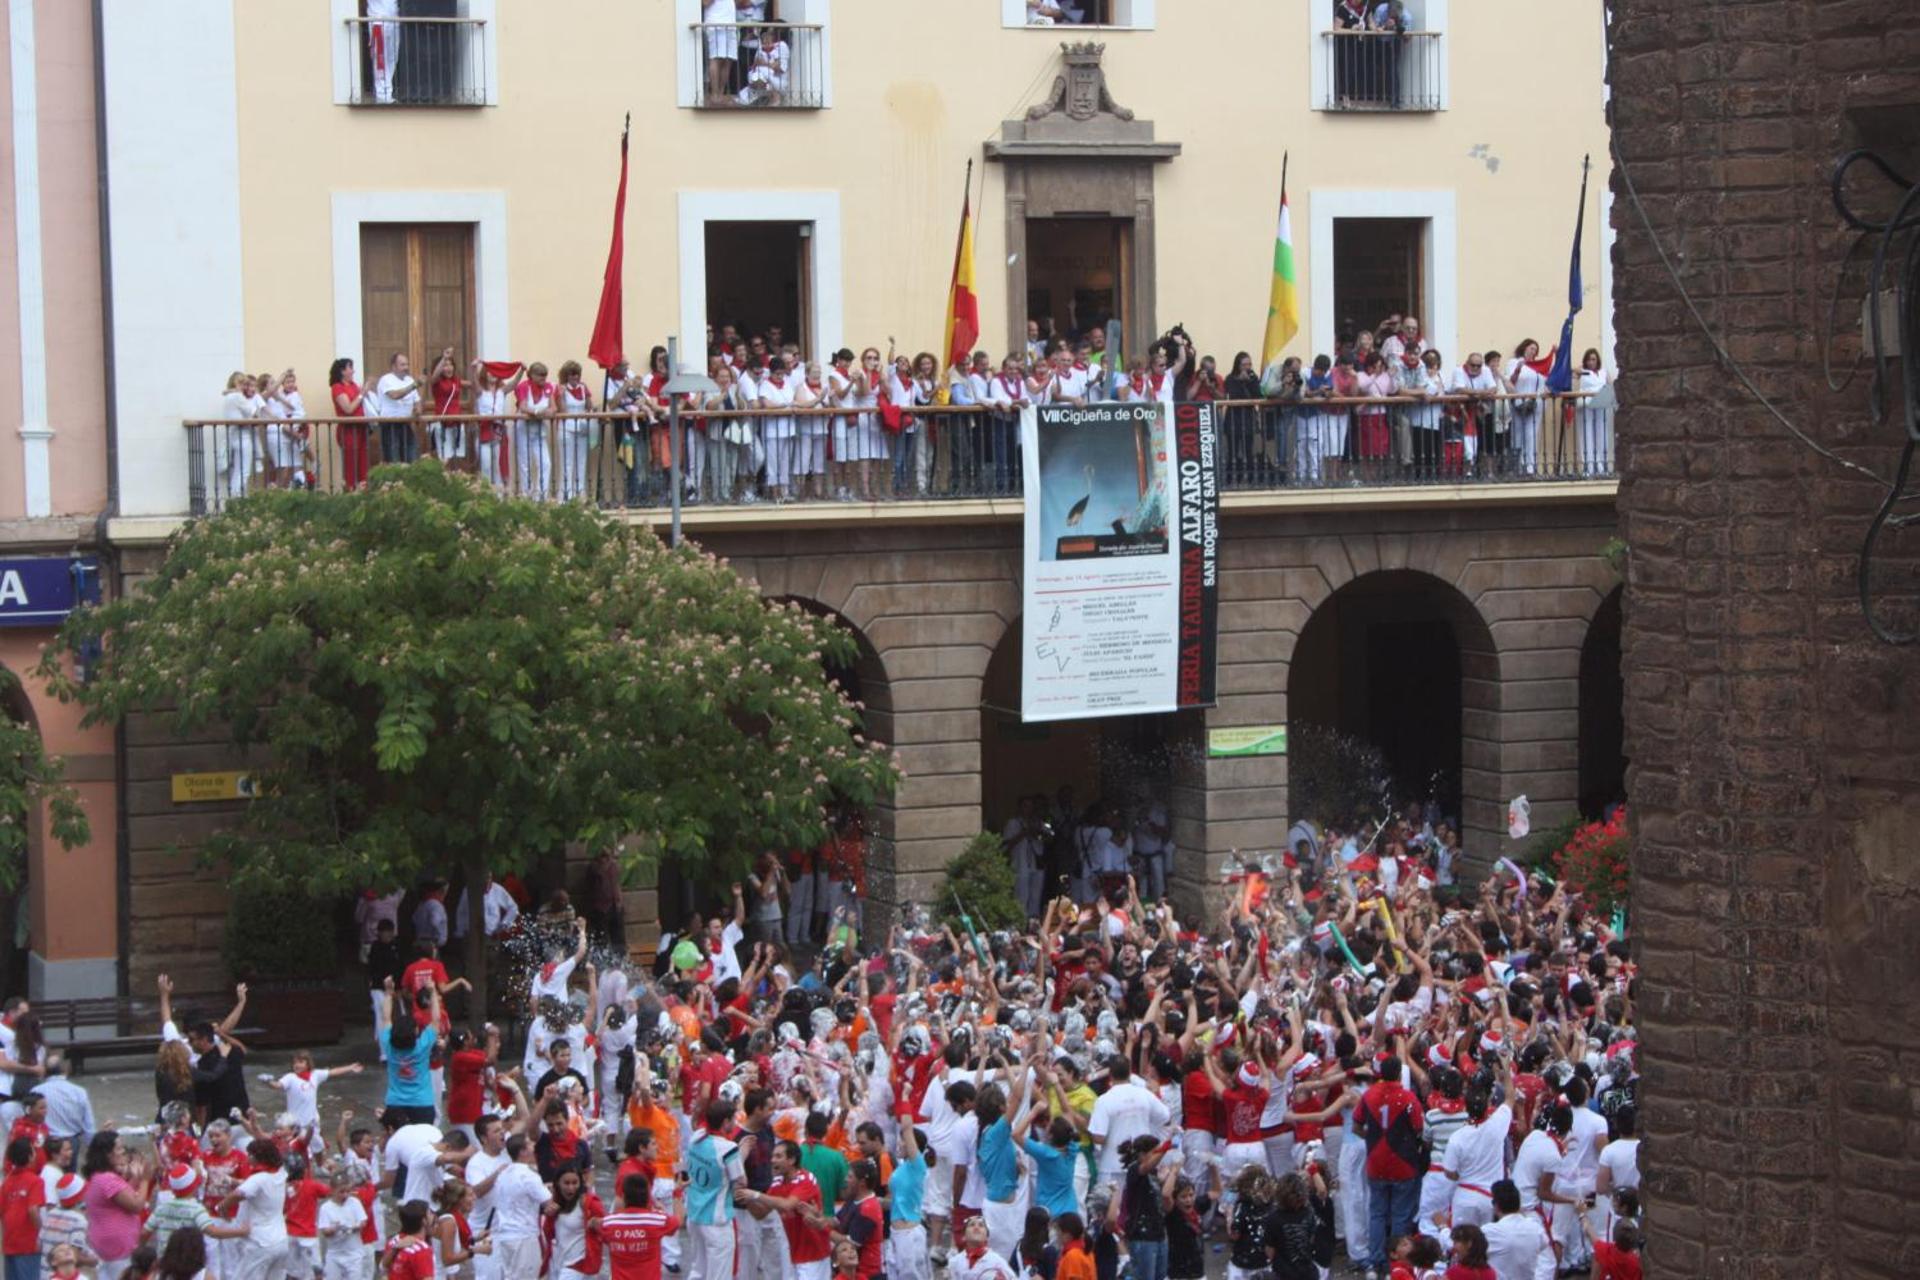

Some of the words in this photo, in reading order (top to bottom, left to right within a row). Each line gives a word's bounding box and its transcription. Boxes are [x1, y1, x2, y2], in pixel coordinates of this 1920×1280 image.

[1042, 408, 1060, 423] VIII
[1060, 407, 1111, 425] Cigüeña
[1115, 408, 1131, 421] de
[1133, 407, 1157, 420] Oro
[1177, 404, 1199, 458] 2010
[1199, 404, 1216, 470] EZEQUIEL
[1201, 470, 1216, 498] SAN
[1180, 460, 1202, 545] ALFARO
[1203, 500, 1216, 510] Y
[1203, 513, 1219, 557] ROQUE
[1203, 559, 1216, 587] SAN
[1182, 547, 1202, 636] TAURINA
[1183, 643, 1201, 705] FERIA
[1379, 1103, 1389, 1129] 1
[623, 1228, 647, 1239] PASO
